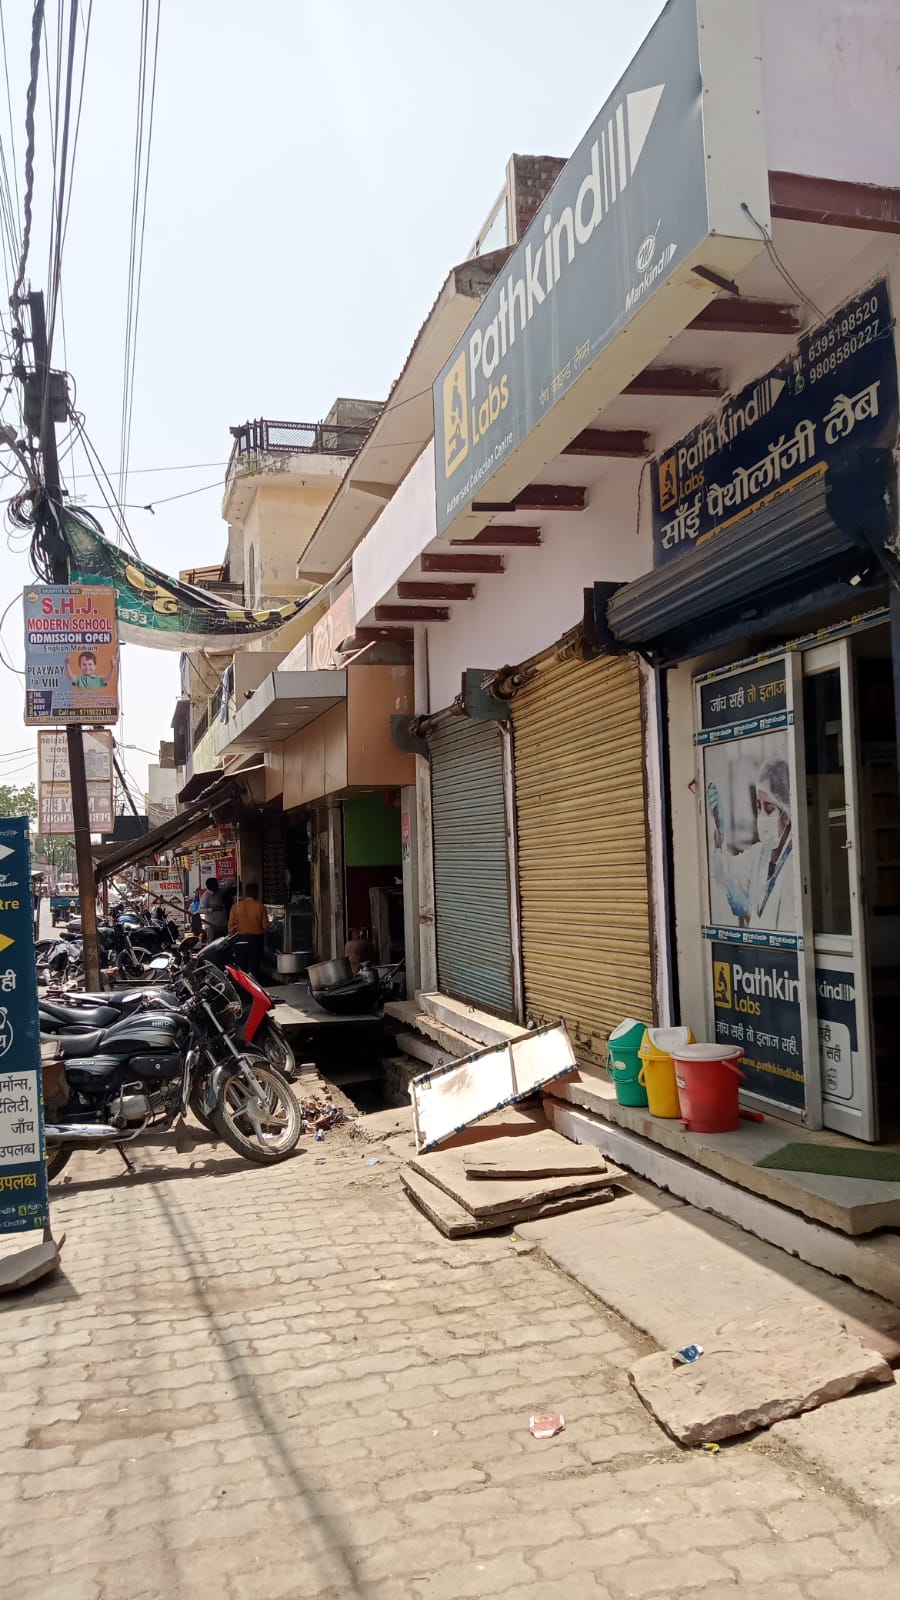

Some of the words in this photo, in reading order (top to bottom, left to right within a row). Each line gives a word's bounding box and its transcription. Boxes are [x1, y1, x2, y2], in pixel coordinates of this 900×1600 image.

[470, 139, 608, 398] Pathkind
[626, 251, 665, 312] Mankind
[808, 297, 878, 361] 6395198520
[809, 319, 879, 384] 9808580227
[472, 374, 509, 446] Labs
[823, 381, 880, 445] लैब
[469, 454, 494, 487] Collection
[494, 431, 513, 460] Centre
[680, 470, 704, 498] Labs
[42, 597, 98, 615] S.H.J.
[28, 619, 69, 631] MODERN
[72, 619, 112, 630] SCHOOL
[30, 633, 82, 643] ADMISSION
[85, 633, 110, 642] OPEN
[28, 666, 65, 676] PLAYWAY
[42, 678, 58, 687] VIII
[709, 694, 728, 713] जांच
[729, 686, 745, 708] सही
[747, 684, 757, 703] तो
[732, 964, 801, 1003] Pathkin
[734, 994, 761, 1016] Labs
[731, 1023, 744, 1040] सही
[746, 1025, 754, 1042] तो
[756, 1031, 779, 1048] इलाज
[10, 1117, 34, 1134] जाँच
